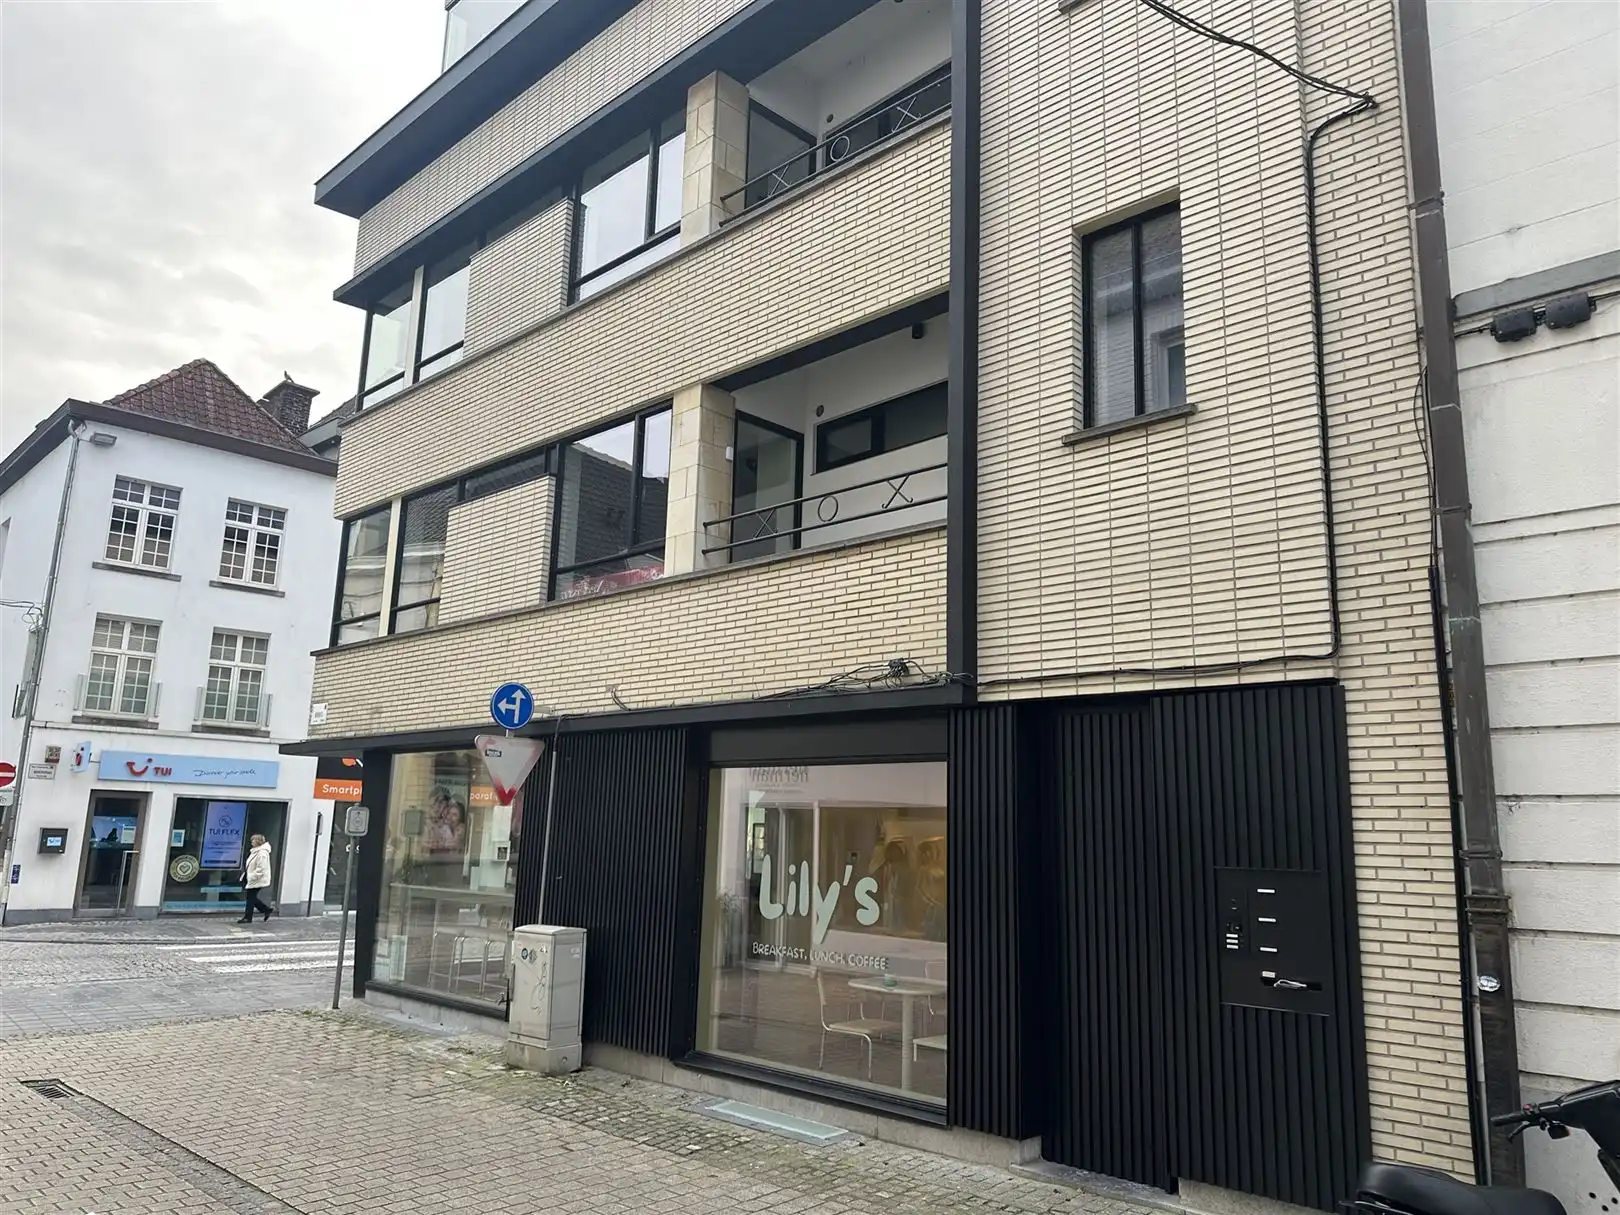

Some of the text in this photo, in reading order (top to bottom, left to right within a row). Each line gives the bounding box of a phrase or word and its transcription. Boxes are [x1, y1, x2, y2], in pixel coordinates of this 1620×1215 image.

[154, 766, 172, 776] TUI
[759, 854, 880, 944] Lily's
[848, 953, 886, 970] COFFEE
